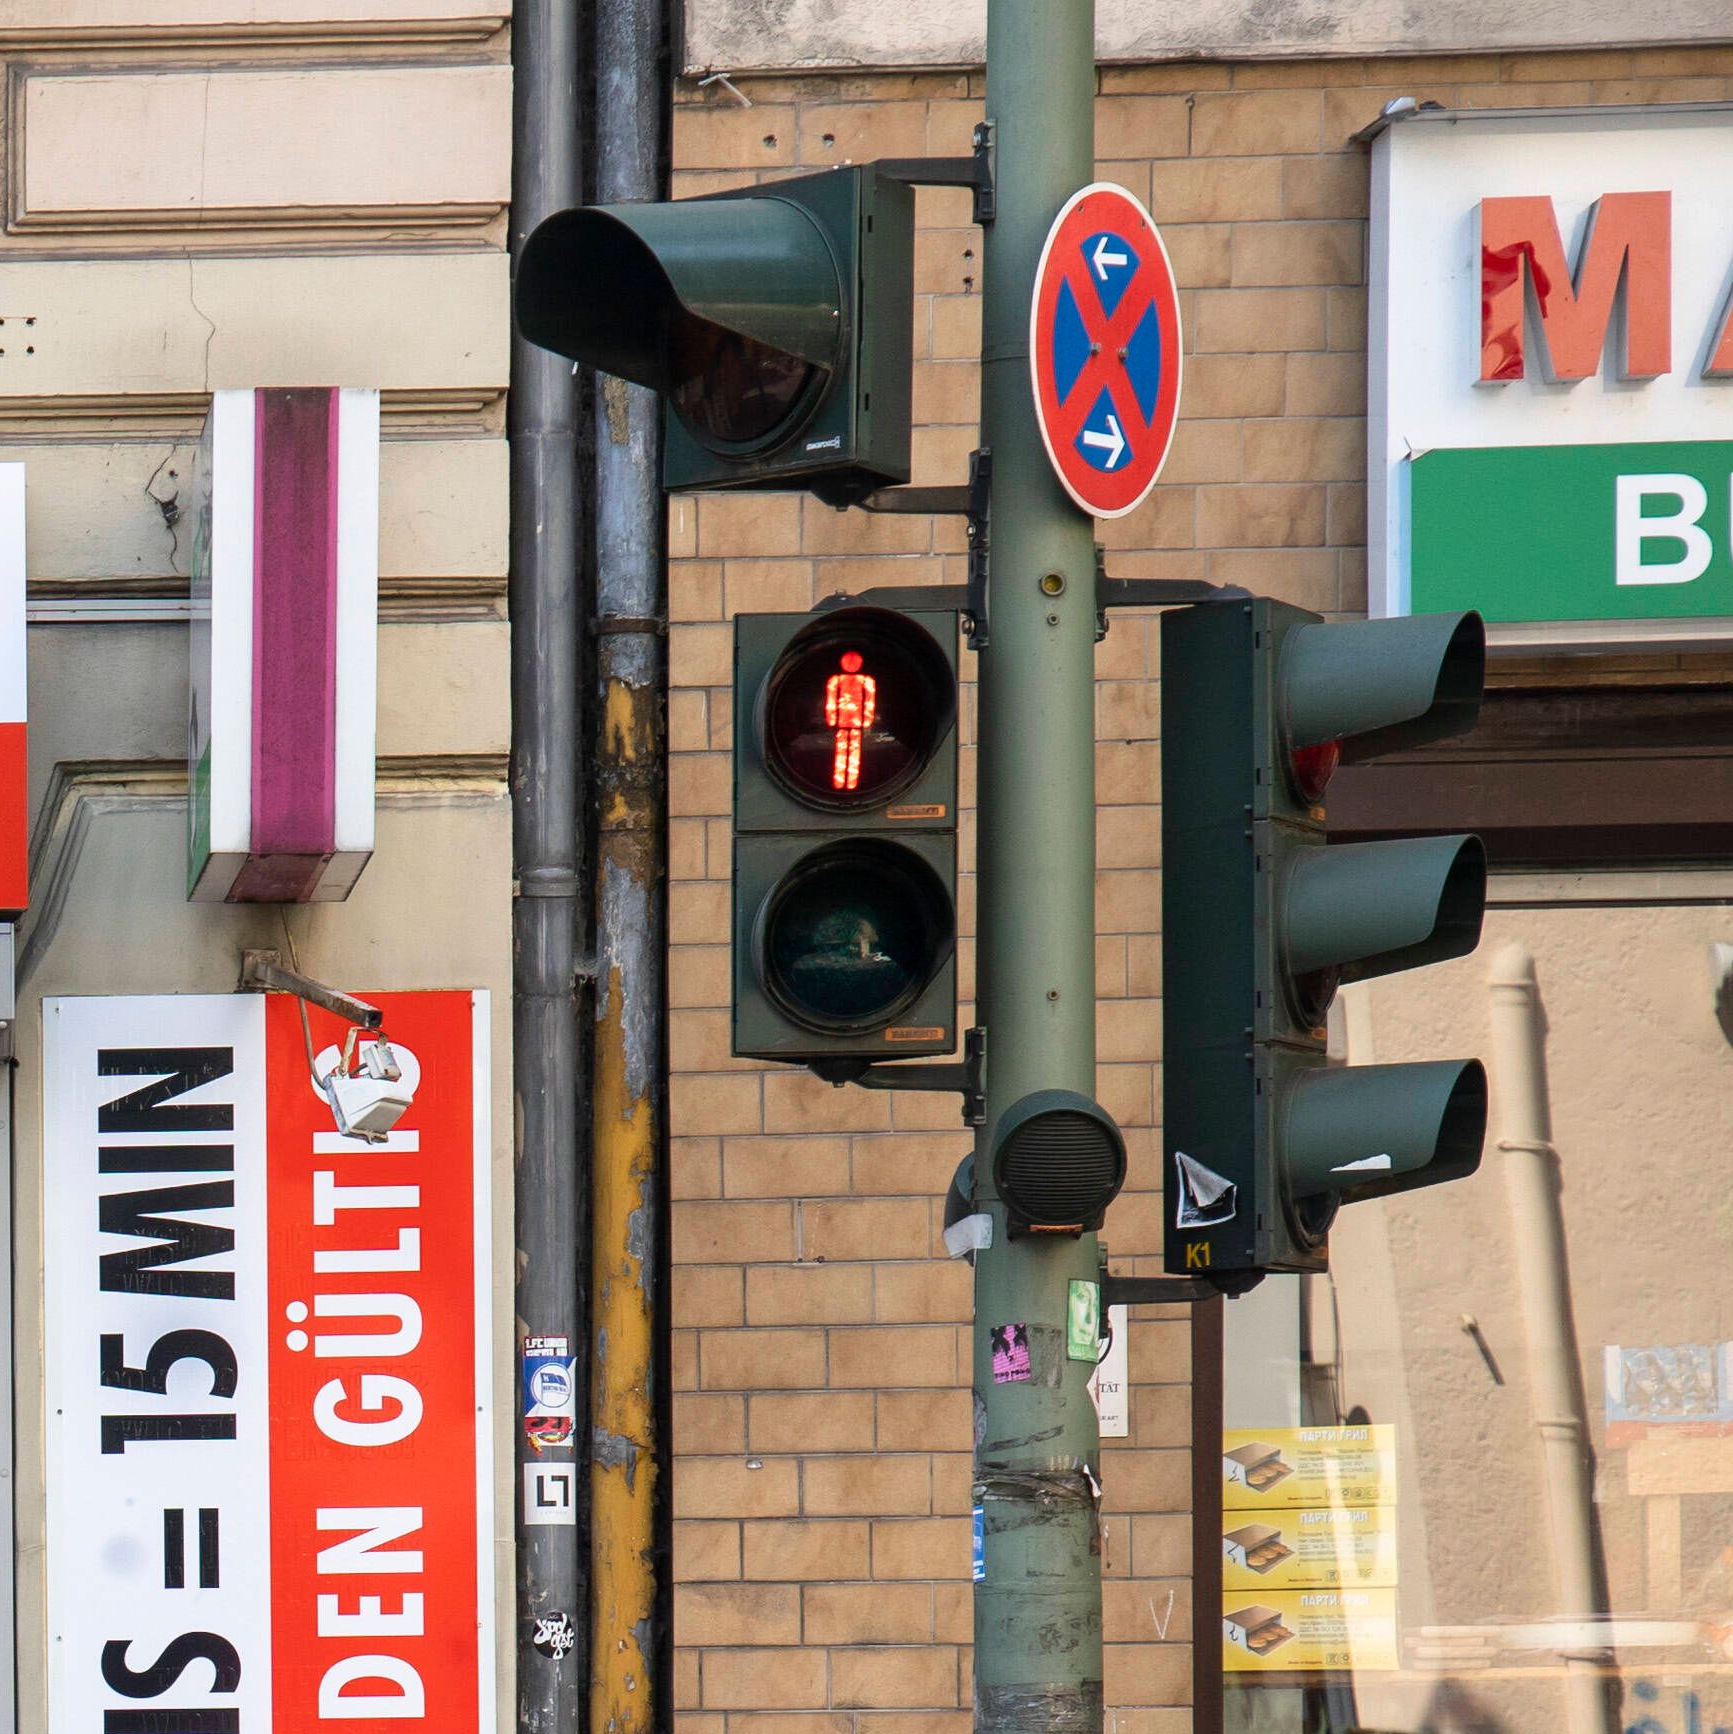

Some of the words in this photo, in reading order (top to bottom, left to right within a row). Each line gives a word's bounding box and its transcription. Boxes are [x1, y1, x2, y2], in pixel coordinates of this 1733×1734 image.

[1474, 190, 1733, 386] M
[1615, 473, 1733, 586] B
[97, 1046, 235, 1300] MIN
[1186, 1242, 1211, 1268] K1
[100, 1329, 238, 1454] 15
